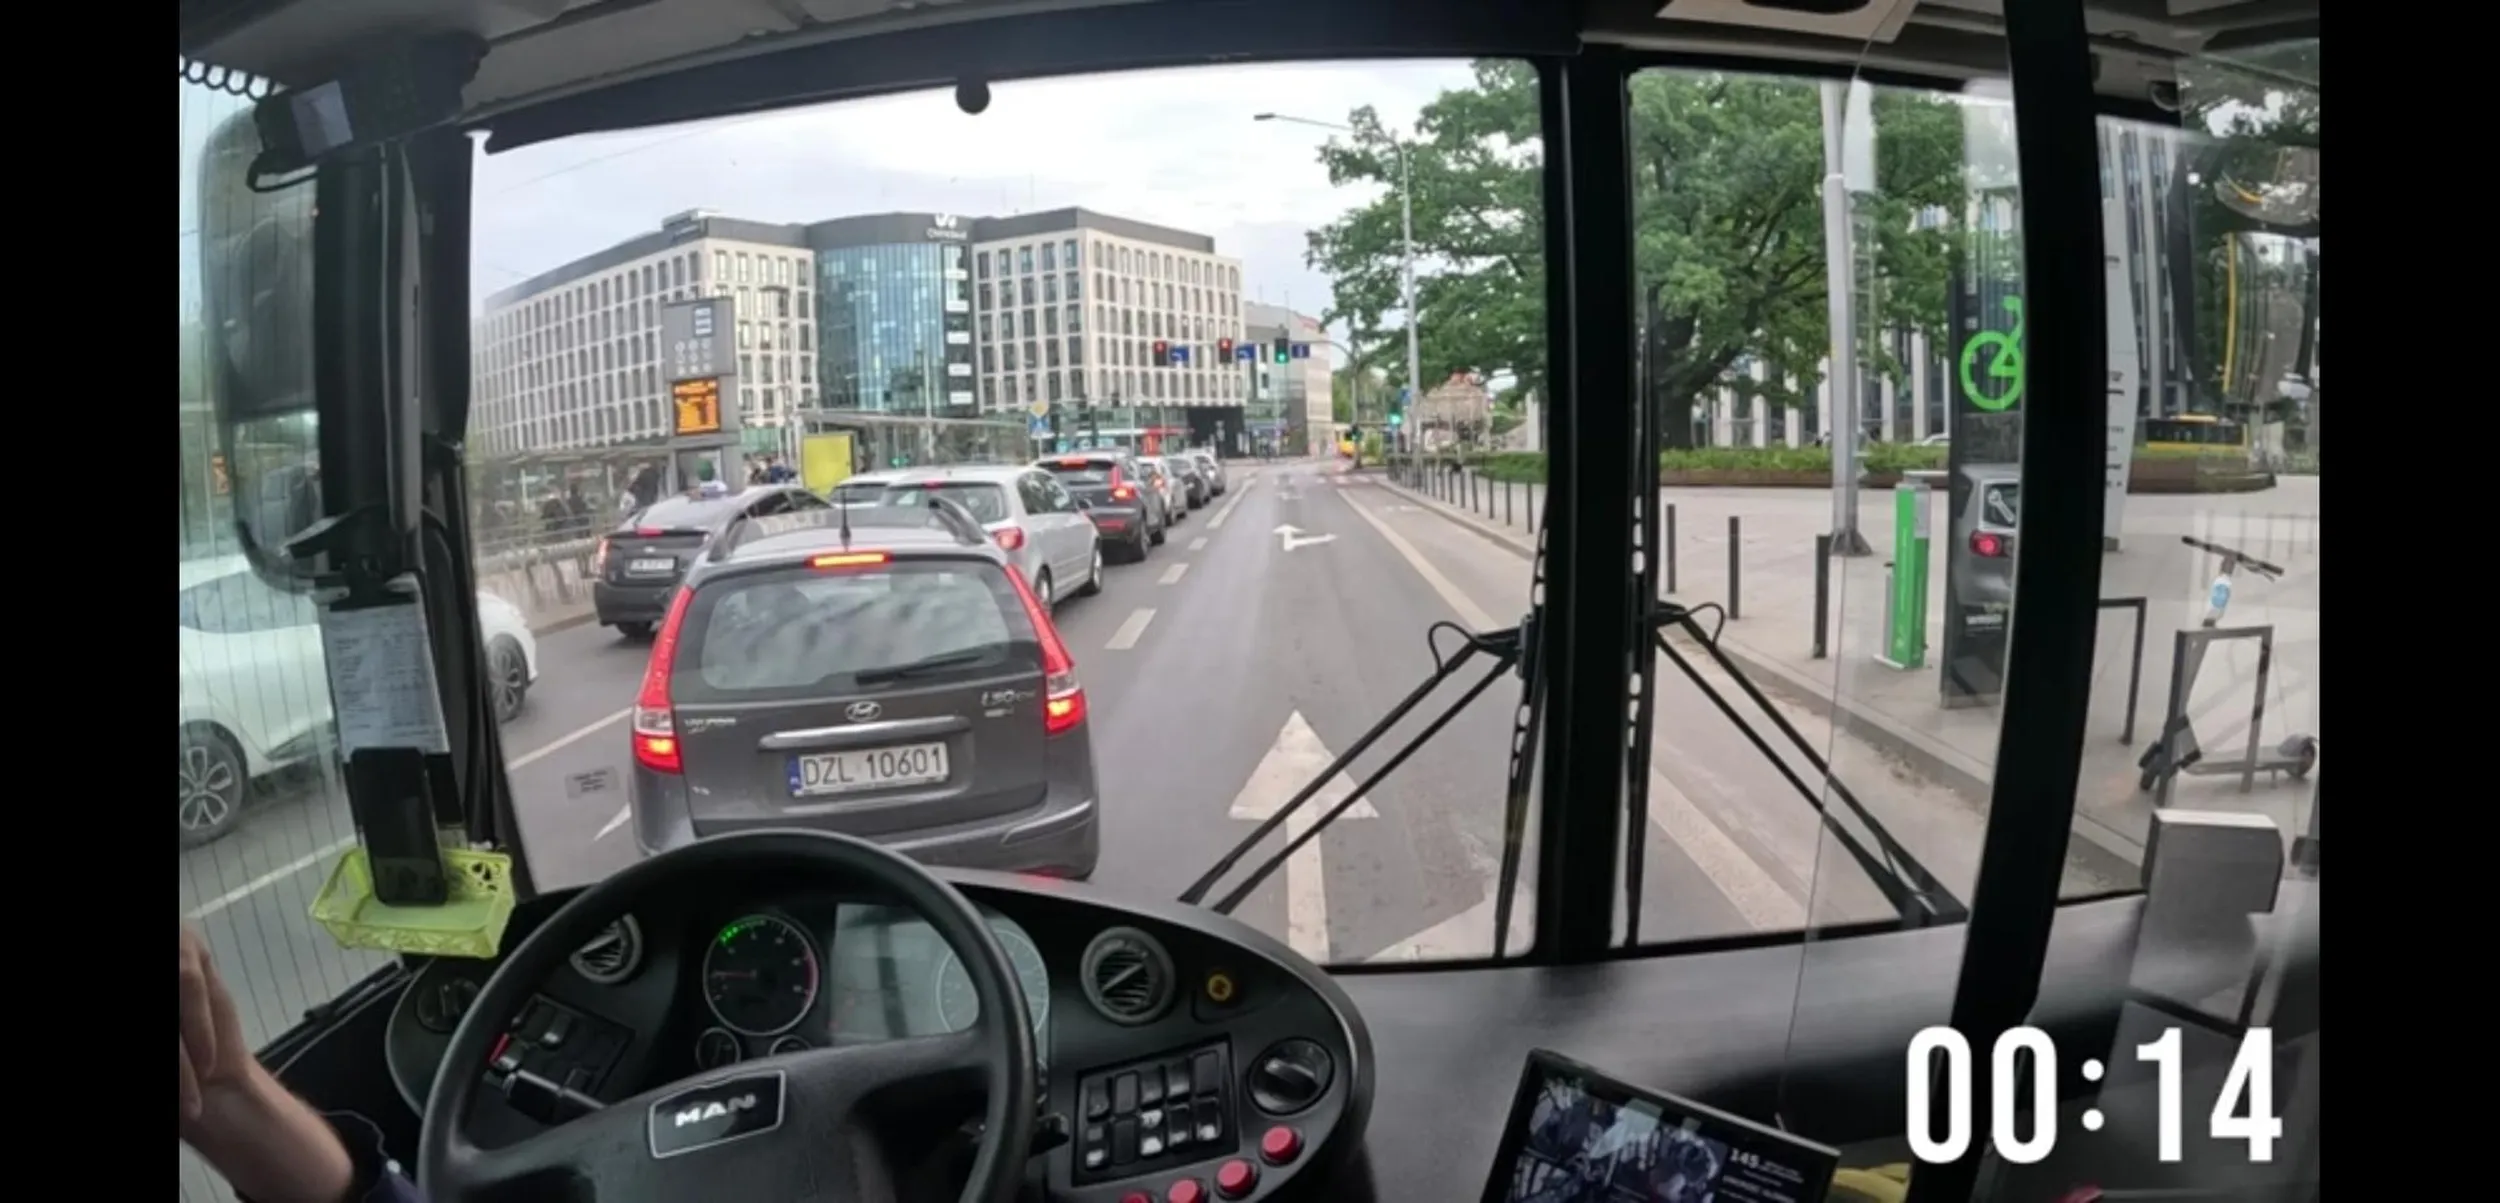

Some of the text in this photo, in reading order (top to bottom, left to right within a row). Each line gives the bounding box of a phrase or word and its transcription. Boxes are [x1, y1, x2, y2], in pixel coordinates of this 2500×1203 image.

[803, 747, 942, 786] DZL 10601
[675, 1094, 756, 1128] MAN
